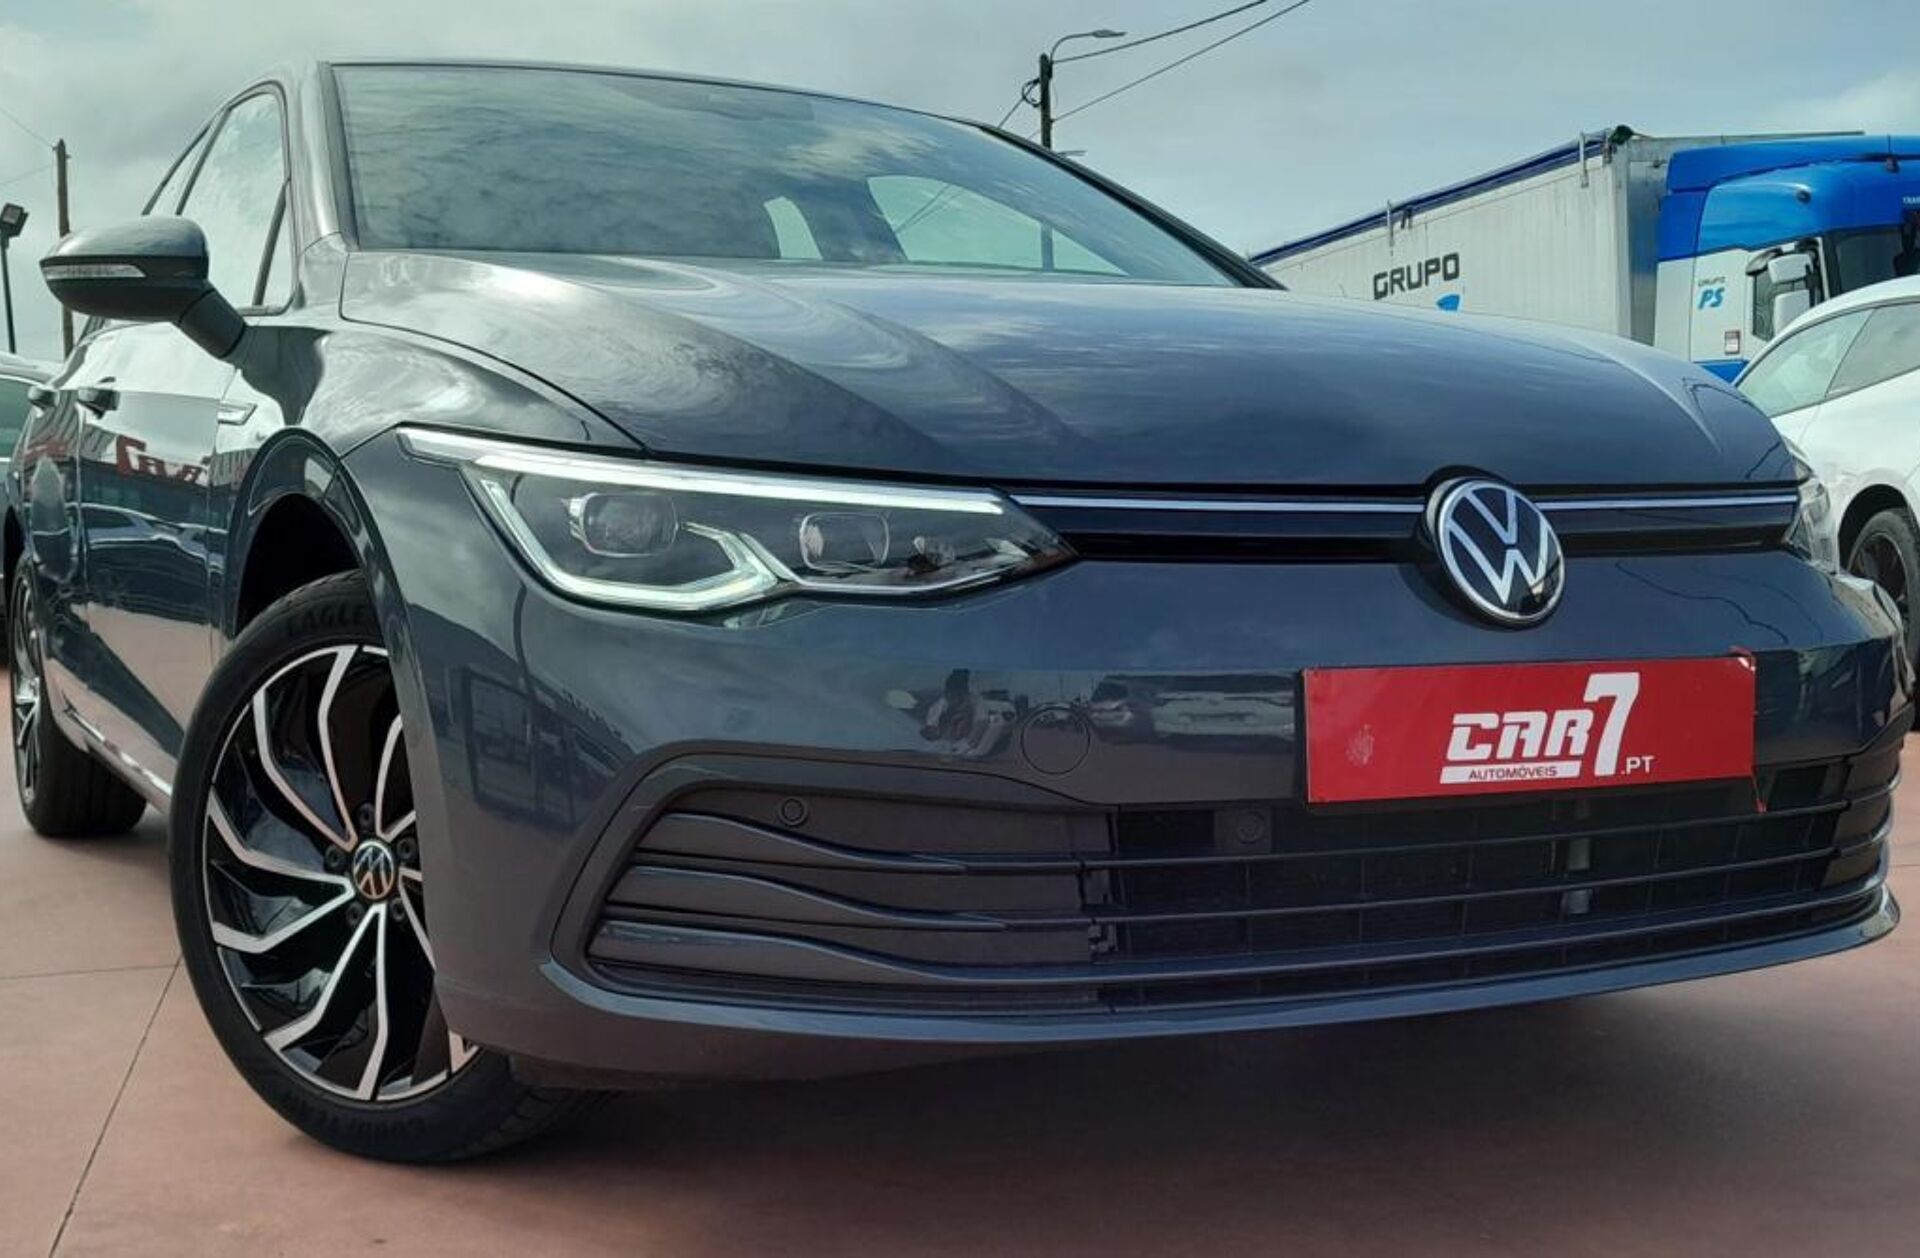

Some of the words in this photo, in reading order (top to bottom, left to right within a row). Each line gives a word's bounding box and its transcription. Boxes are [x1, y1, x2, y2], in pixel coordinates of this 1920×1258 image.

[1373, 252, 1460, 300] GRUPO
[1698, 287, 1725, 310] PS
[1468, 765, 1558, 780] AUTOMÓVEIS
